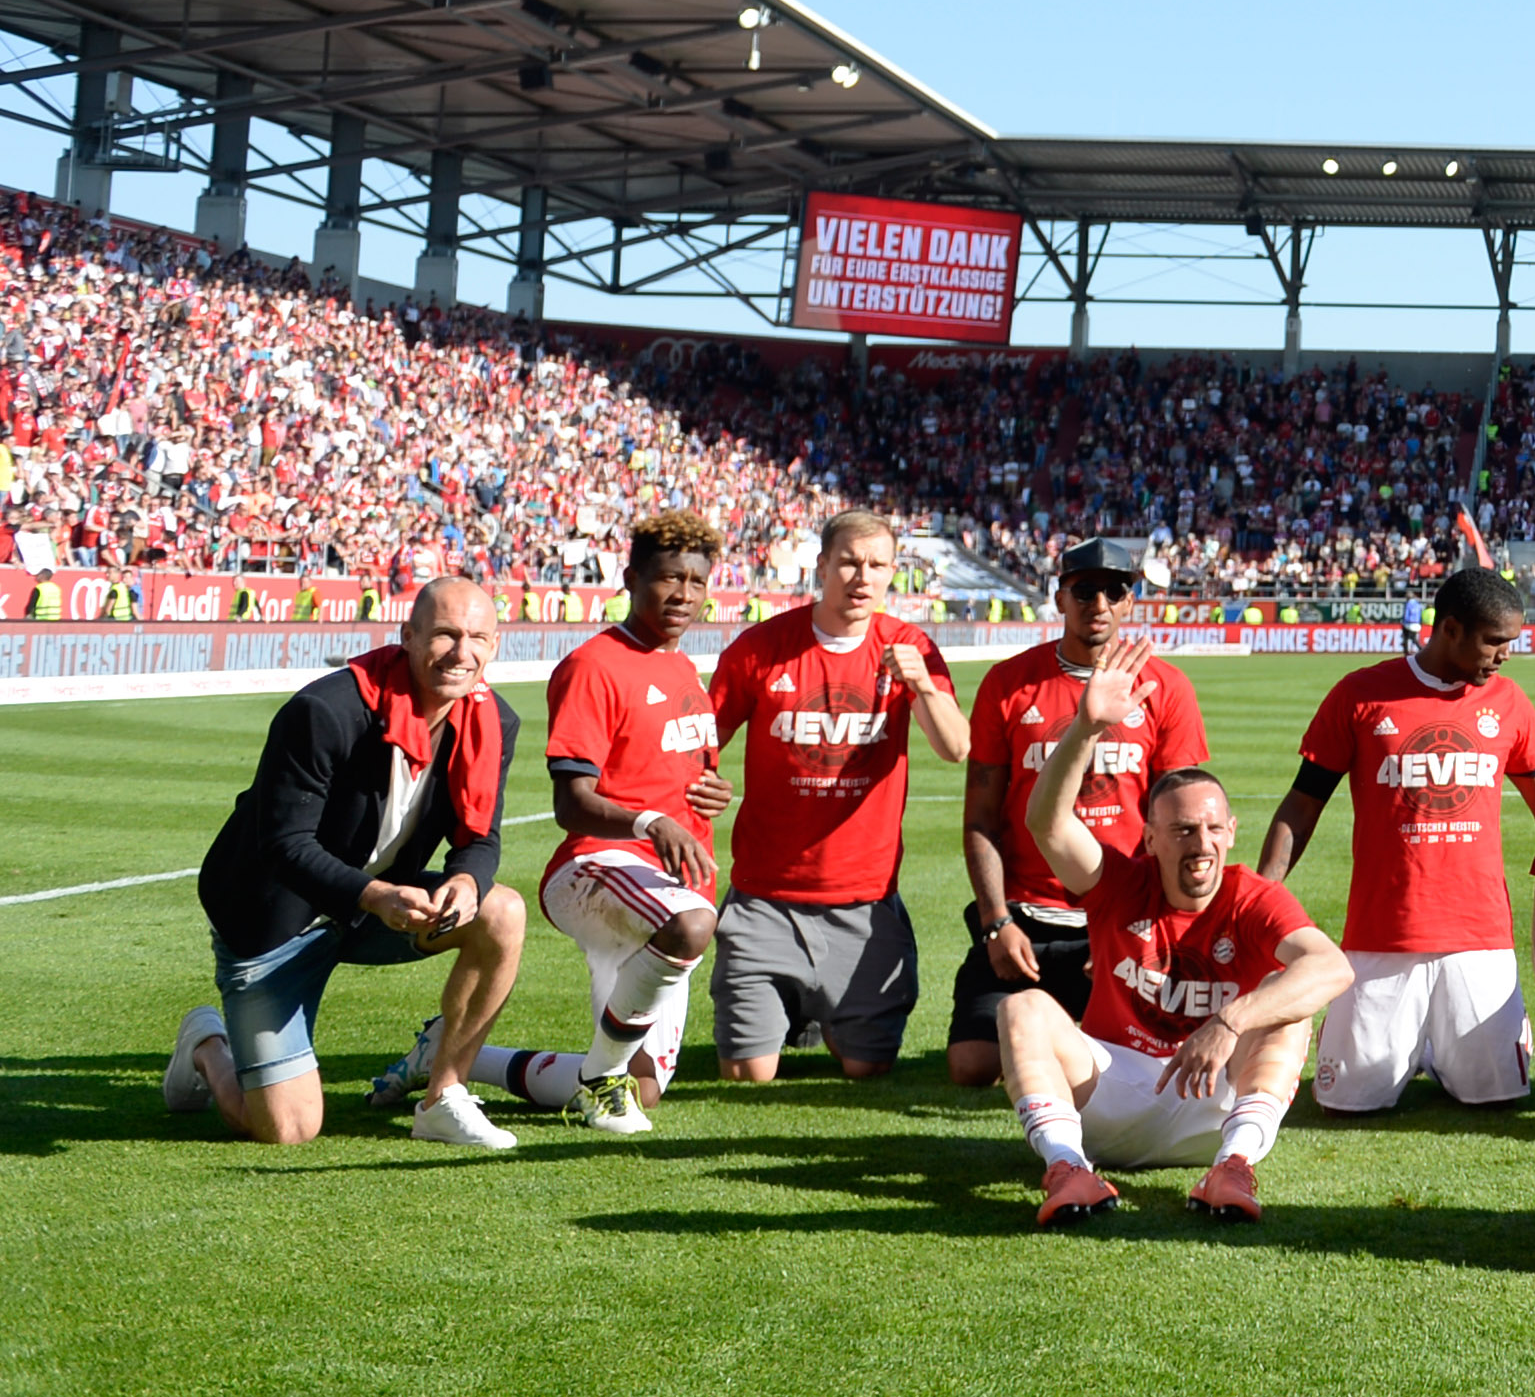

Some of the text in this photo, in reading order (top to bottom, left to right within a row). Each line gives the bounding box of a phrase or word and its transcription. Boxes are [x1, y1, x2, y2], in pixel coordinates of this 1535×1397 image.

[816, 216, 1011, 270] VIELEN DANK
[811, 253, 1007, 292] FÜR EURE ERSTKLASSIGE
[808, 279, 1003, 321] UNTERSTÜTZUNG!
[157, 585, 220, 621] Audi
[29, 624, 214, 678] UNTERSTÜTZUNG!
[224, 633, 283, 670] DANKE
[1240, 627, 1309, 652] DANKE
[1312, 627, 1408, 653] SCHANZE
[661, 713, 718, 753] 4EVE
[1022, 741, 1144, 774] 4ER
[1377, 752, 1499, 788] 4EVER
[1401, 821, 1480, 833] DEUTSCHER MEISTER
[1113, 956, 1240, 1018] 4EVER
